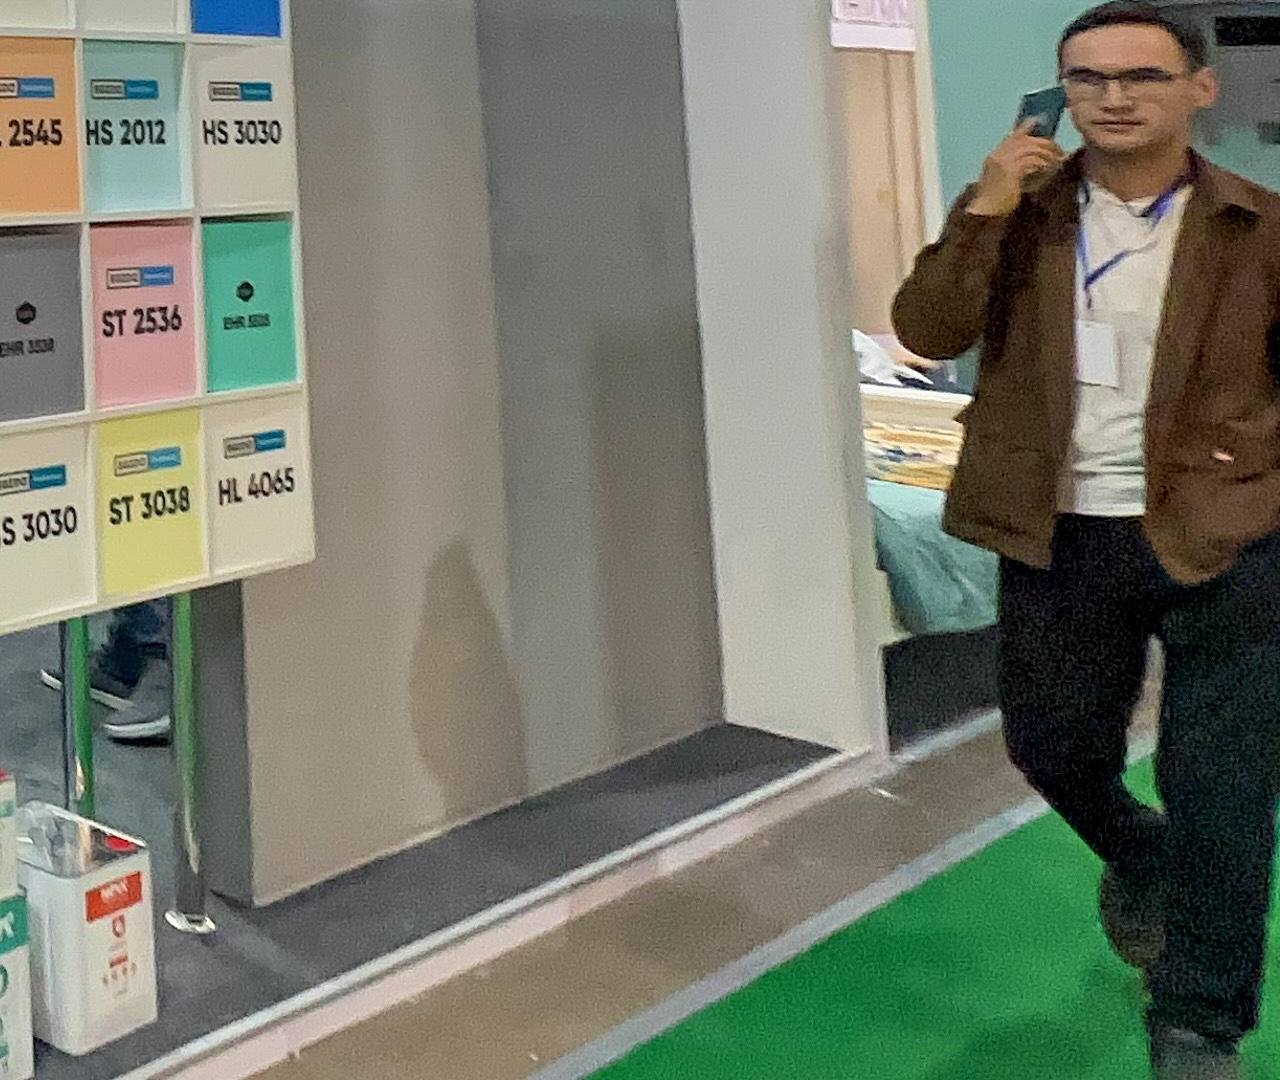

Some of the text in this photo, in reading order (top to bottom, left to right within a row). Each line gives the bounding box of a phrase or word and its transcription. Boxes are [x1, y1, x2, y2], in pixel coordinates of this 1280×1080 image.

[8, 118, 63, 147] 2545
[85, 119, 166, 146] HS 2012
[202, 119, 282, 146] HS 3030
[102, 304, 183, 338] ST 2536
[218, 467, 295, 506] HL 4065
[108, 485, 190, 525] ST 3038
[22, 505, 78, 542] 3030
